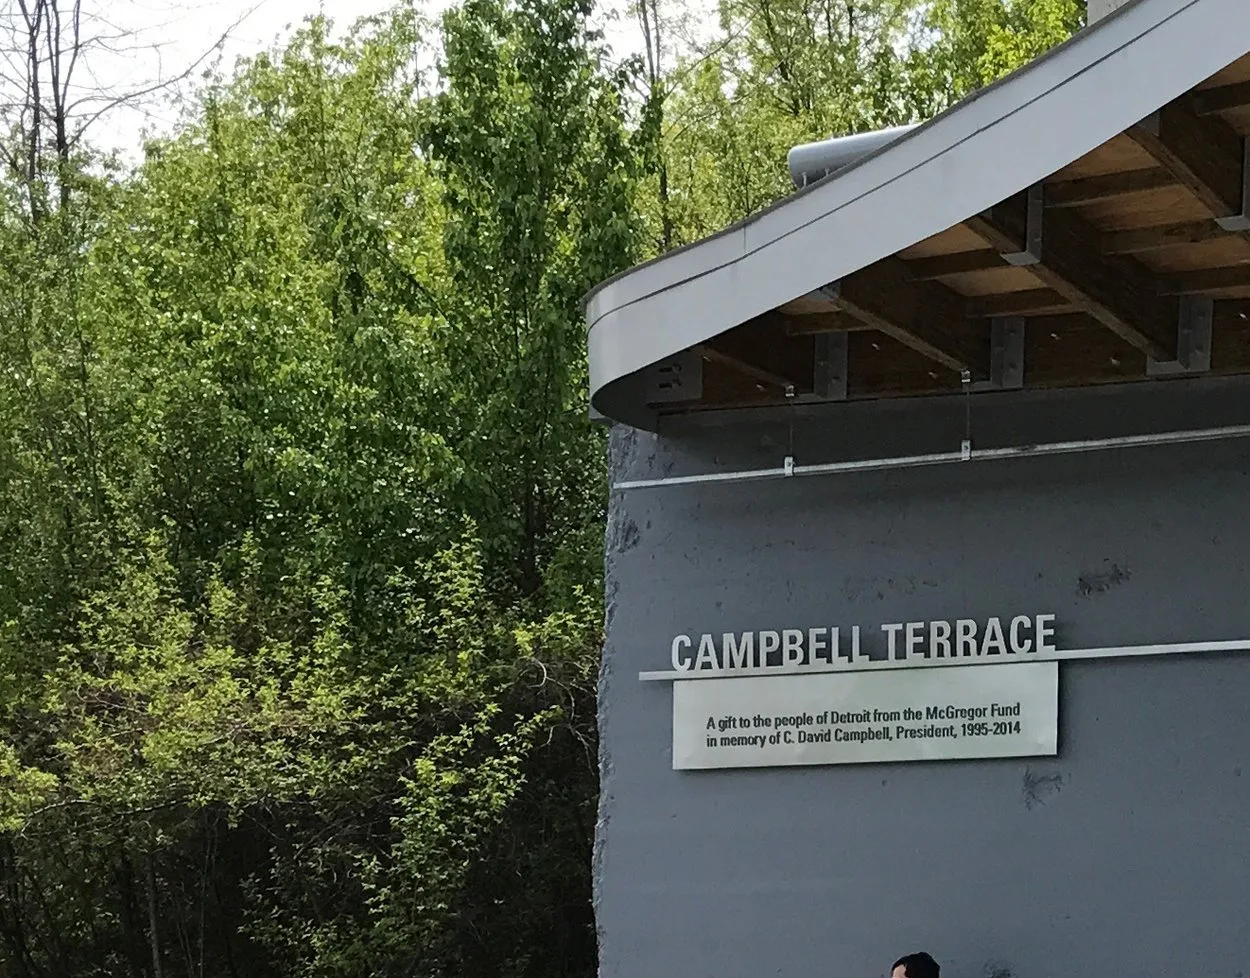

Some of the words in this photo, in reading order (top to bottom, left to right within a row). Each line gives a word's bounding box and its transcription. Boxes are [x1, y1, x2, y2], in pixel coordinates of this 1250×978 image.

[671, 624, 871, 672] CAMPBELL
[880, 613, 1056, 662] TERRACE
[706, 716, 717, 730] A
[718, 715, 738, 733] gift
[739, 716, 751, 729] to
[753, 714, 772, 728] the
[774, 712, 814, 730] people
[816, 711, 829, 725] of
[831, 709, 871, 724] Detroit
[873, 708, 901, 722] from
[903, 707, 923, 721] the
[926, 704, 988, 721] McGregor
[991, 702, 1021, 717] Fund
[706, 734, 717, 747] in
[720, 735, 767, 749] memory
[769, 731, 781, 745] of
[783, 730, 795, 744] C.
[798, 729, 831, 743] David
[834, 726, 893, 743] Campbell,
[896, 724, 958, 739] President,
[961, 721, 1021, 737] 1995-2014
